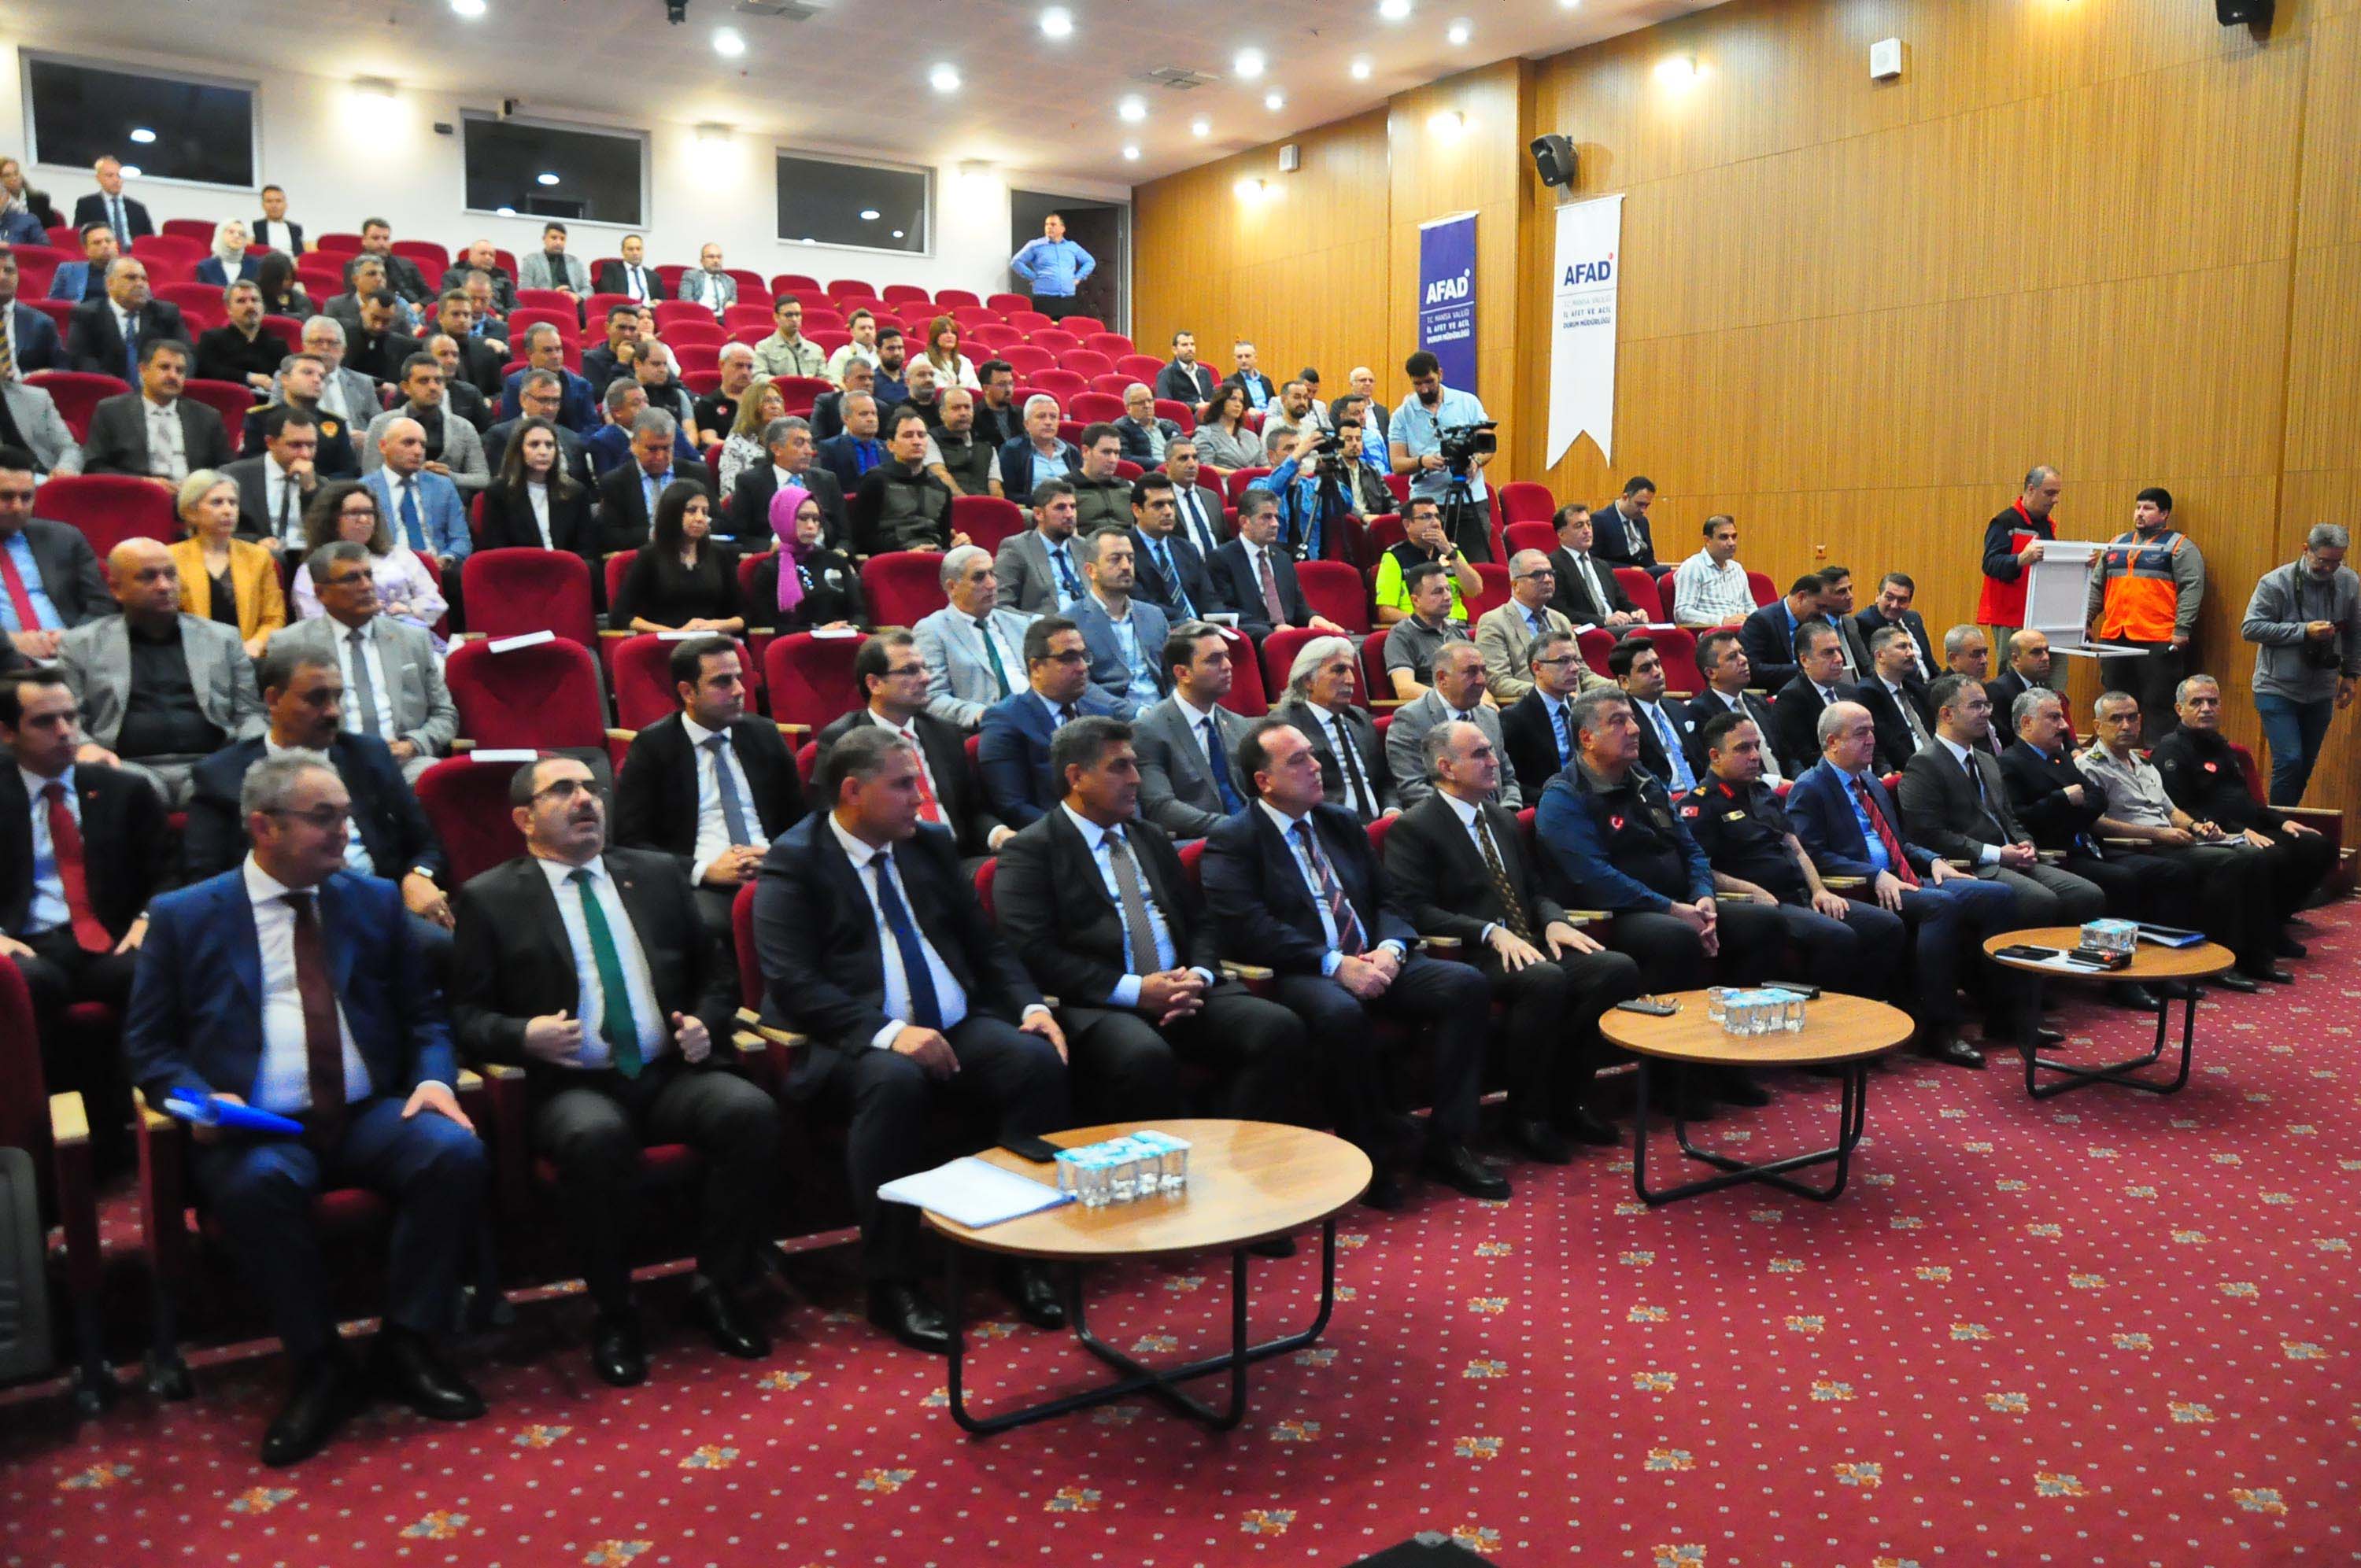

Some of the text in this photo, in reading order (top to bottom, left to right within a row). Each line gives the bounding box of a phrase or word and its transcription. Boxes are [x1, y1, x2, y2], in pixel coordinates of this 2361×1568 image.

[1564, 260, 1611, 286] AFAD
[1425, 275, 1469, 305] AFAD
[1434, 323, 1447, 333] AFET
[1448, 321, 1456, 330] VE
[1563, 320, 1580, 329] DURUM
